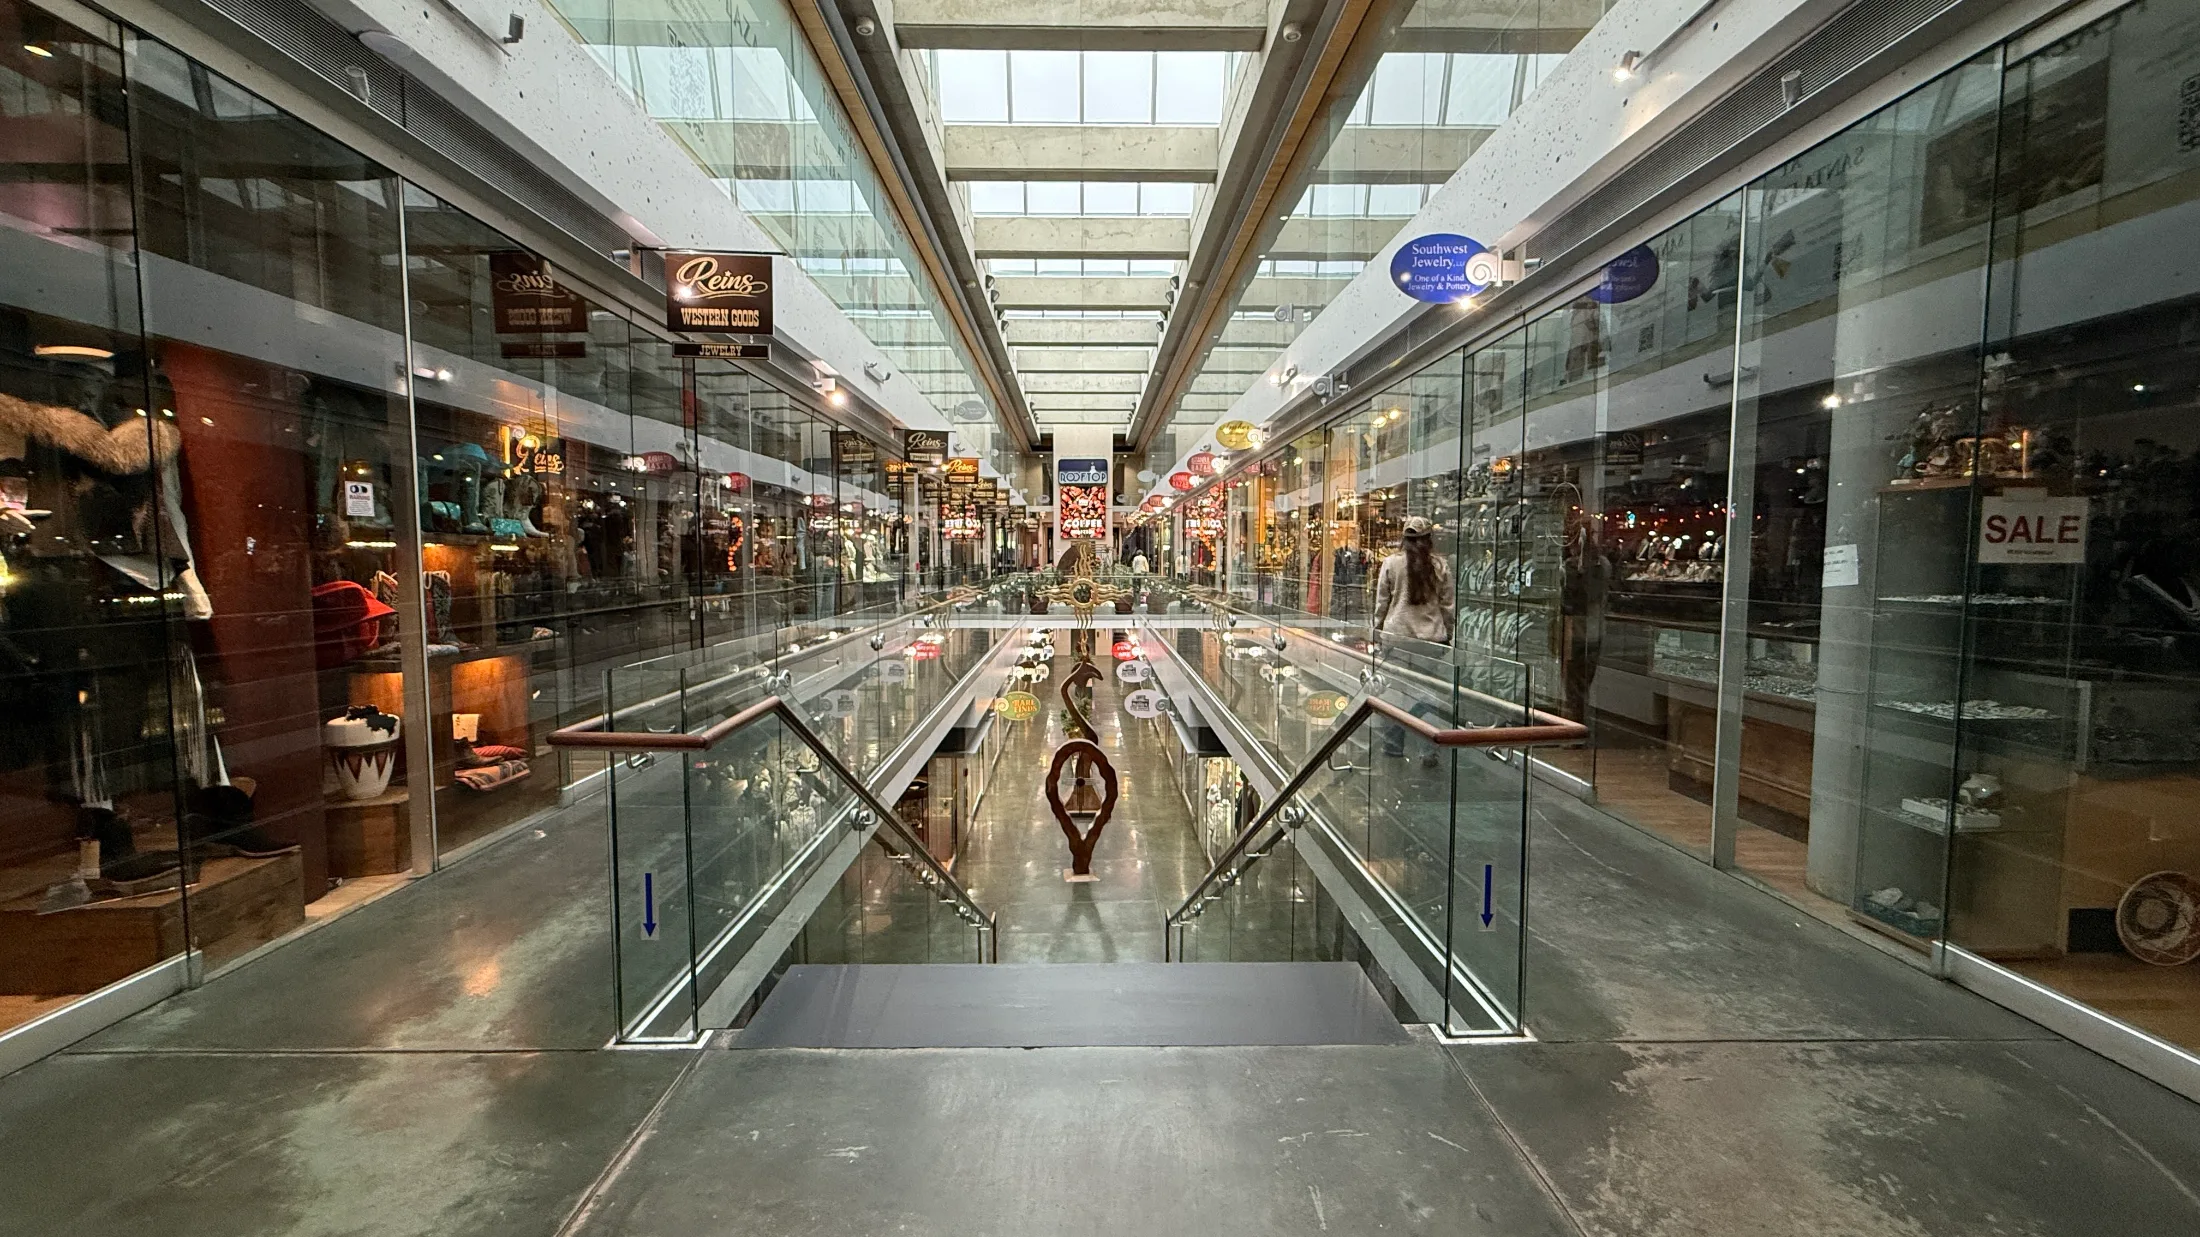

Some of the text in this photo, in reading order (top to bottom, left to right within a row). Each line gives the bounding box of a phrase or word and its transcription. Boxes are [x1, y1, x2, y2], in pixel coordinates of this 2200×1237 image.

[1412, 243, 1468, 255] Southwest
[676, 256, 768, 299] Reins
[1414, 274, 1430, 282] One
[1431, 273, 1440, 282] of
[1446, 273, 1465, 282] Kind
[1408, 283, 1471, 292] Jewelry & Pottery
[680, 307, 760, 328] WESTERN GOODS
[699, 344, 743, 357] JEWELRY
[907, 432, 947, 451] Reins
[948, 458, 978, 475] Reins
[1060, 472, 1107, 482] ROOFTOP
[1065, 518, 1103, 528] COFFEE
[1984, 514, 2081, 544] SALE
